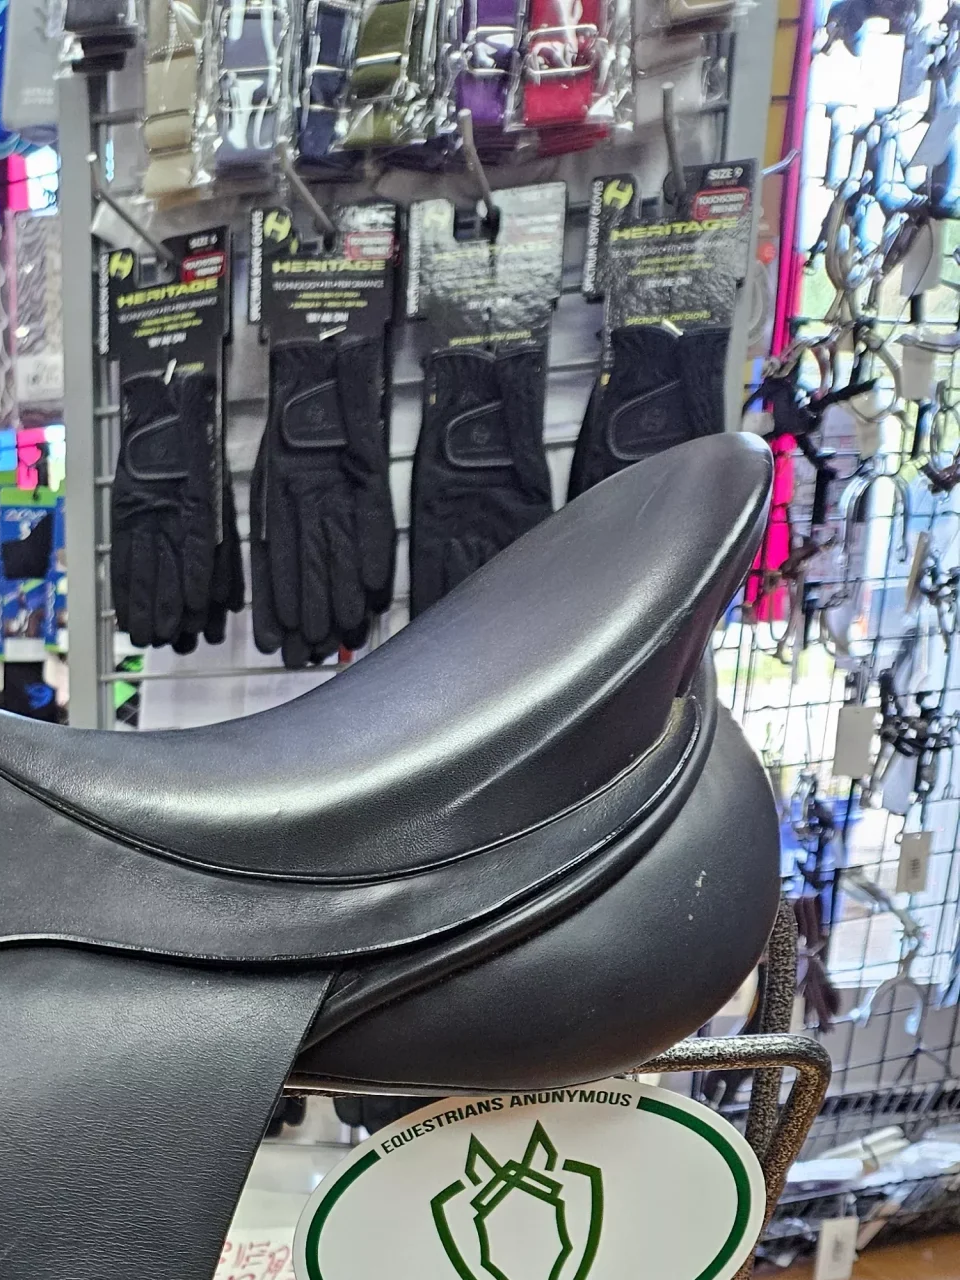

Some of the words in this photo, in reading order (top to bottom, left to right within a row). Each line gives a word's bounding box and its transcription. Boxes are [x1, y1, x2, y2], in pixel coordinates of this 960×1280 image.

[706, 168, 734, 180] SIZE
[734, 166, 744, 179] 9
[592, 181, 604, 216] GLOVES
[587, 217, 601, 247] SHOW
[609, 217, 740, 242] HERITAGE
[271, 260, 386, 273] HERITAGE
[582, 248, 597, 293] SPECTRUM
[116, 278, 218, 308] HERITAGE
[380, 1097, 504, 1154] EQUESTRIANS
[509, 1089, 632, 1108] ANONYMOUS
